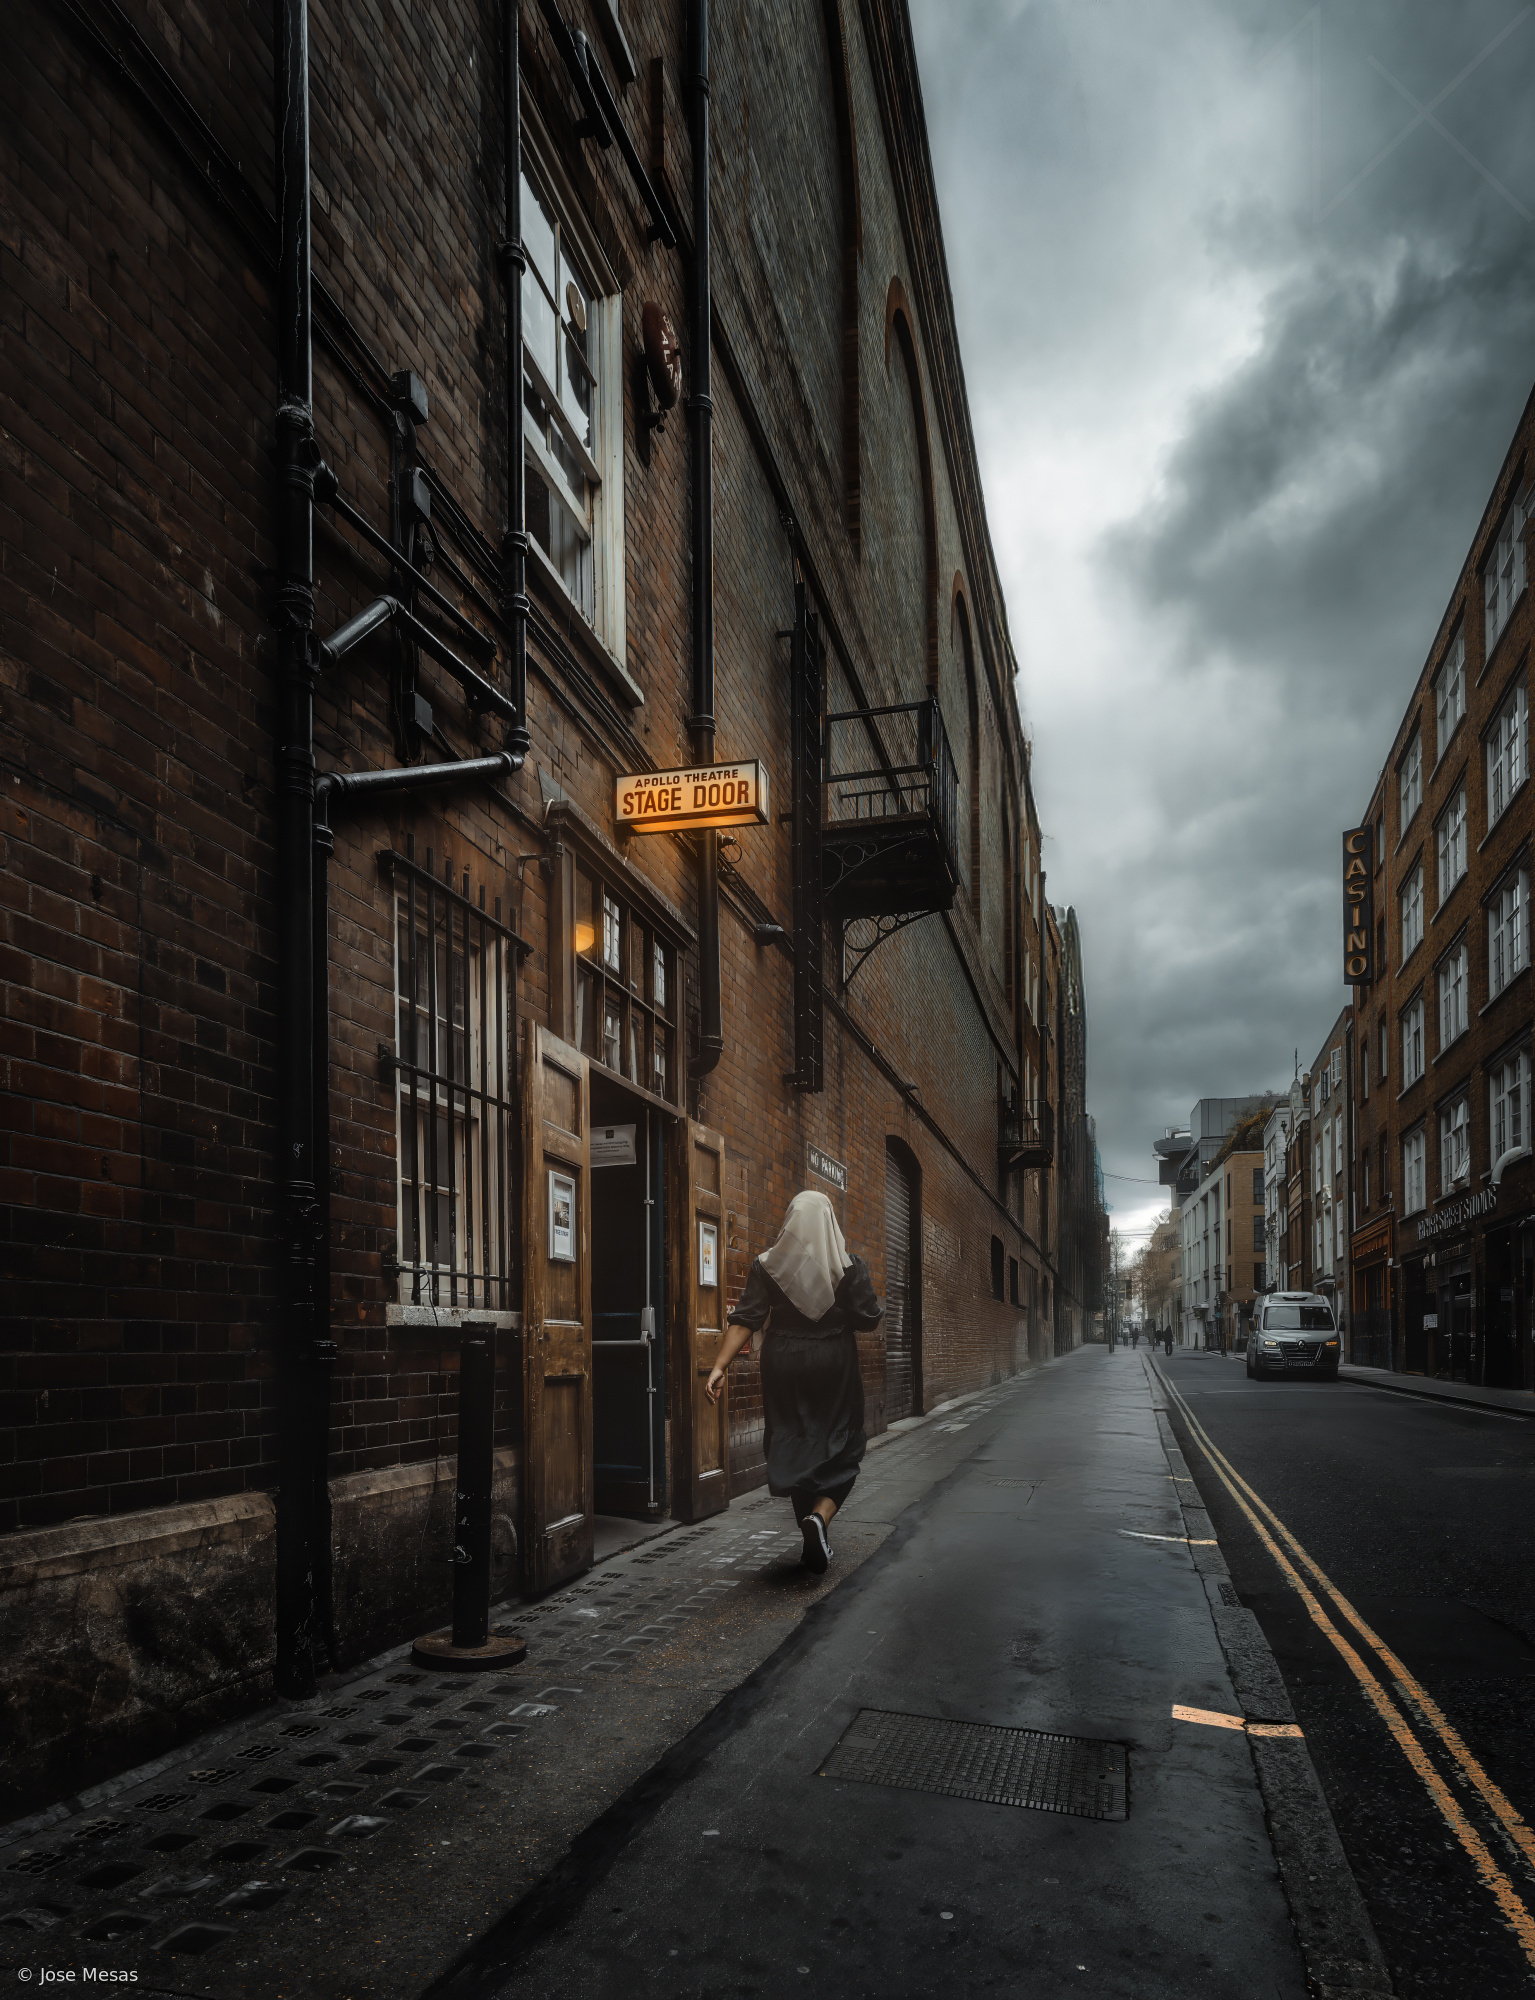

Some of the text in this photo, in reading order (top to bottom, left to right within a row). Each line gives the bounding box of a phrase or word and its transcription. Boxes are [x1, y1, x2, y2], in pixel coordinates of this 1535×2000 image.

[634, 769, 739, 789] APOLLO THEATRE
[622, 780, 749, 816] STAGE DOOR
[1345, 831, 1367, 976] CASINO
[810, 1149, 819, 1168] NO
